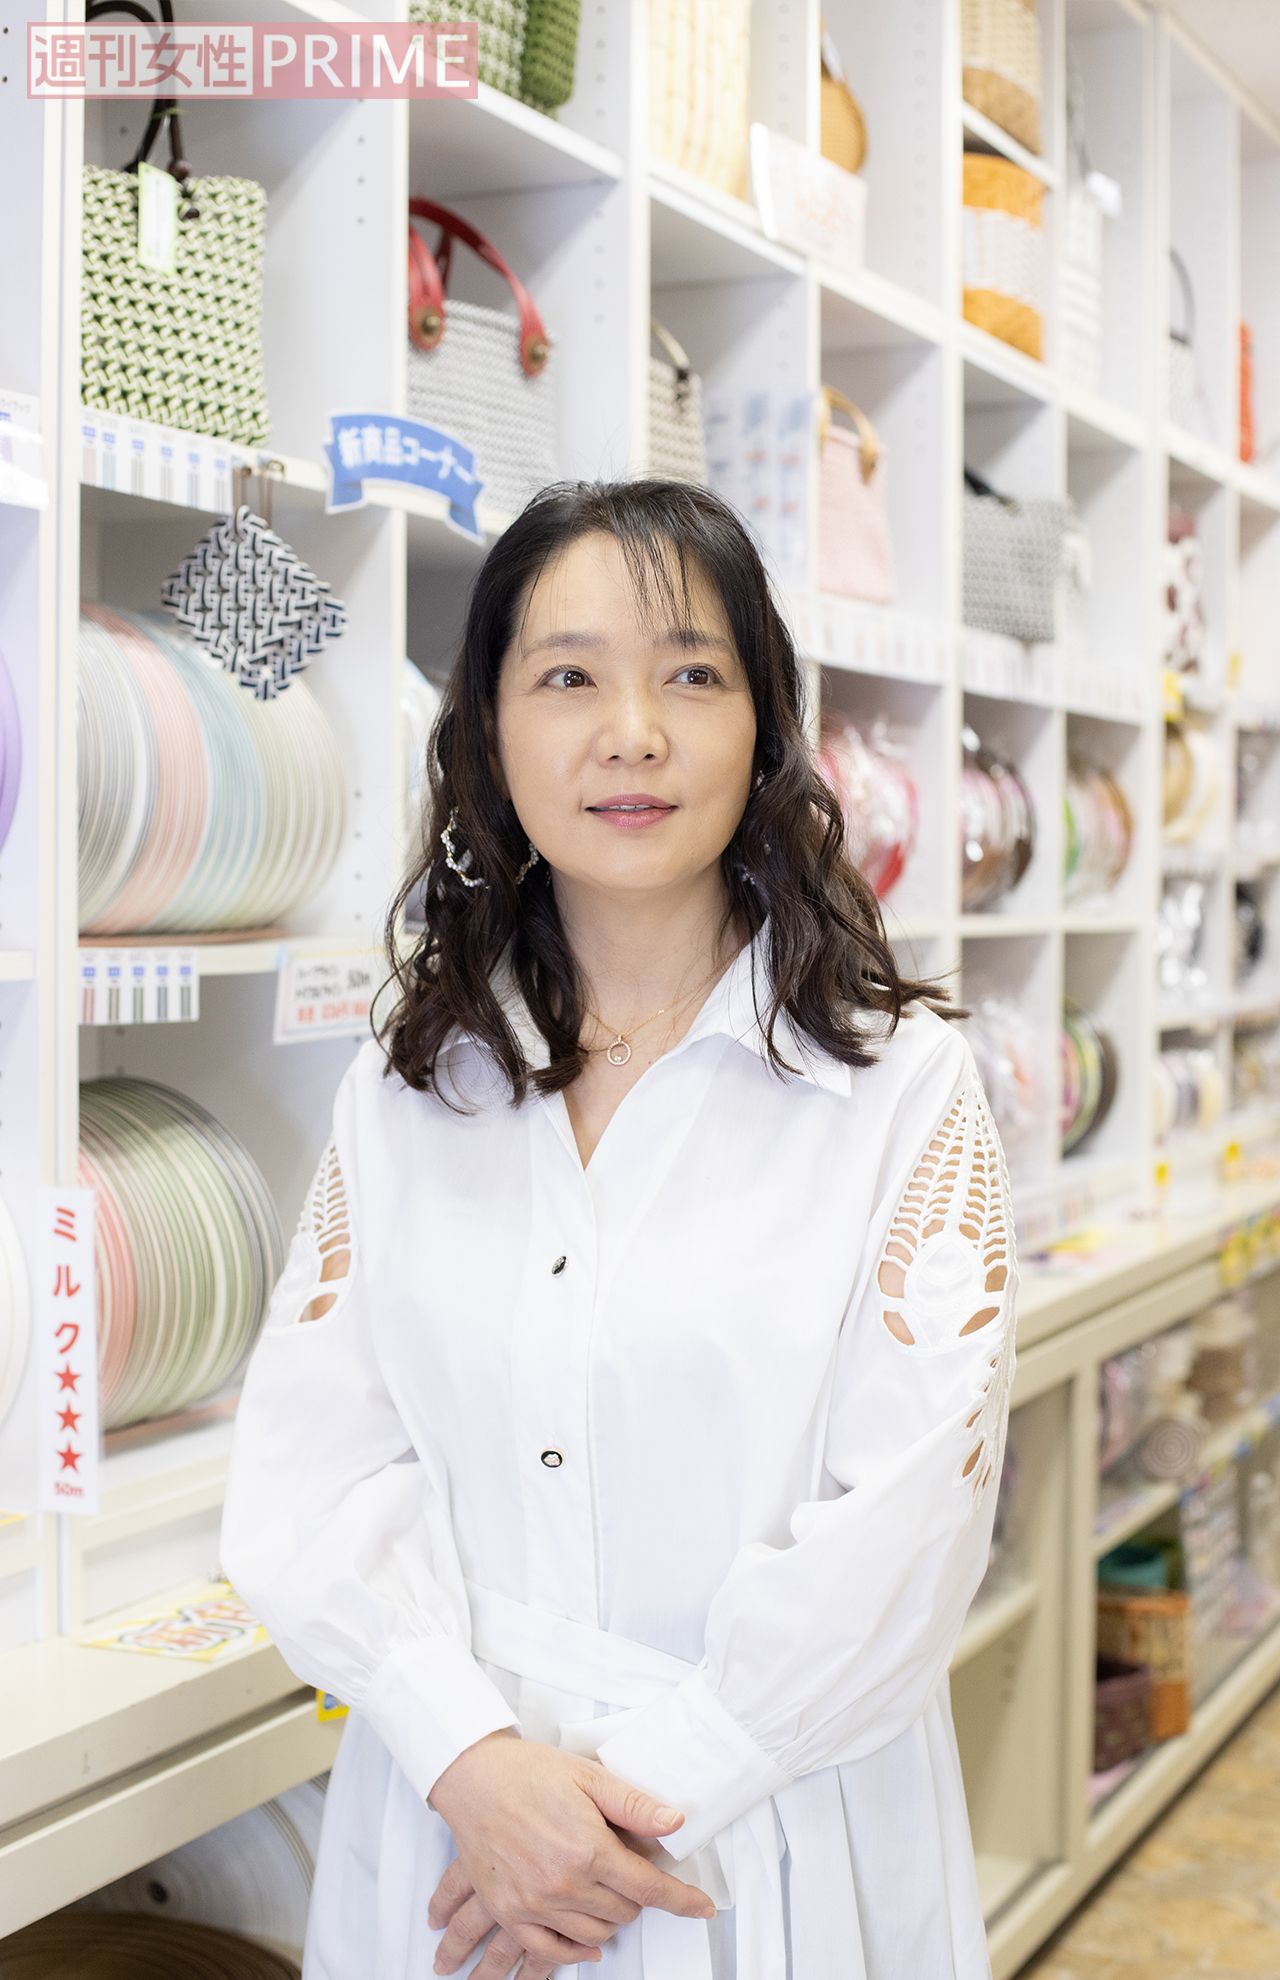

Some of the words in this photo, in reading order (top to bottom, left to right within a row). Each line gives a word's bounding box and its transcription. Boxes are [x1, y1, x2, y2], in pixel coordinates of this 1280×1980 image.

[338, 423, 475, 484] 新商品コーナー
